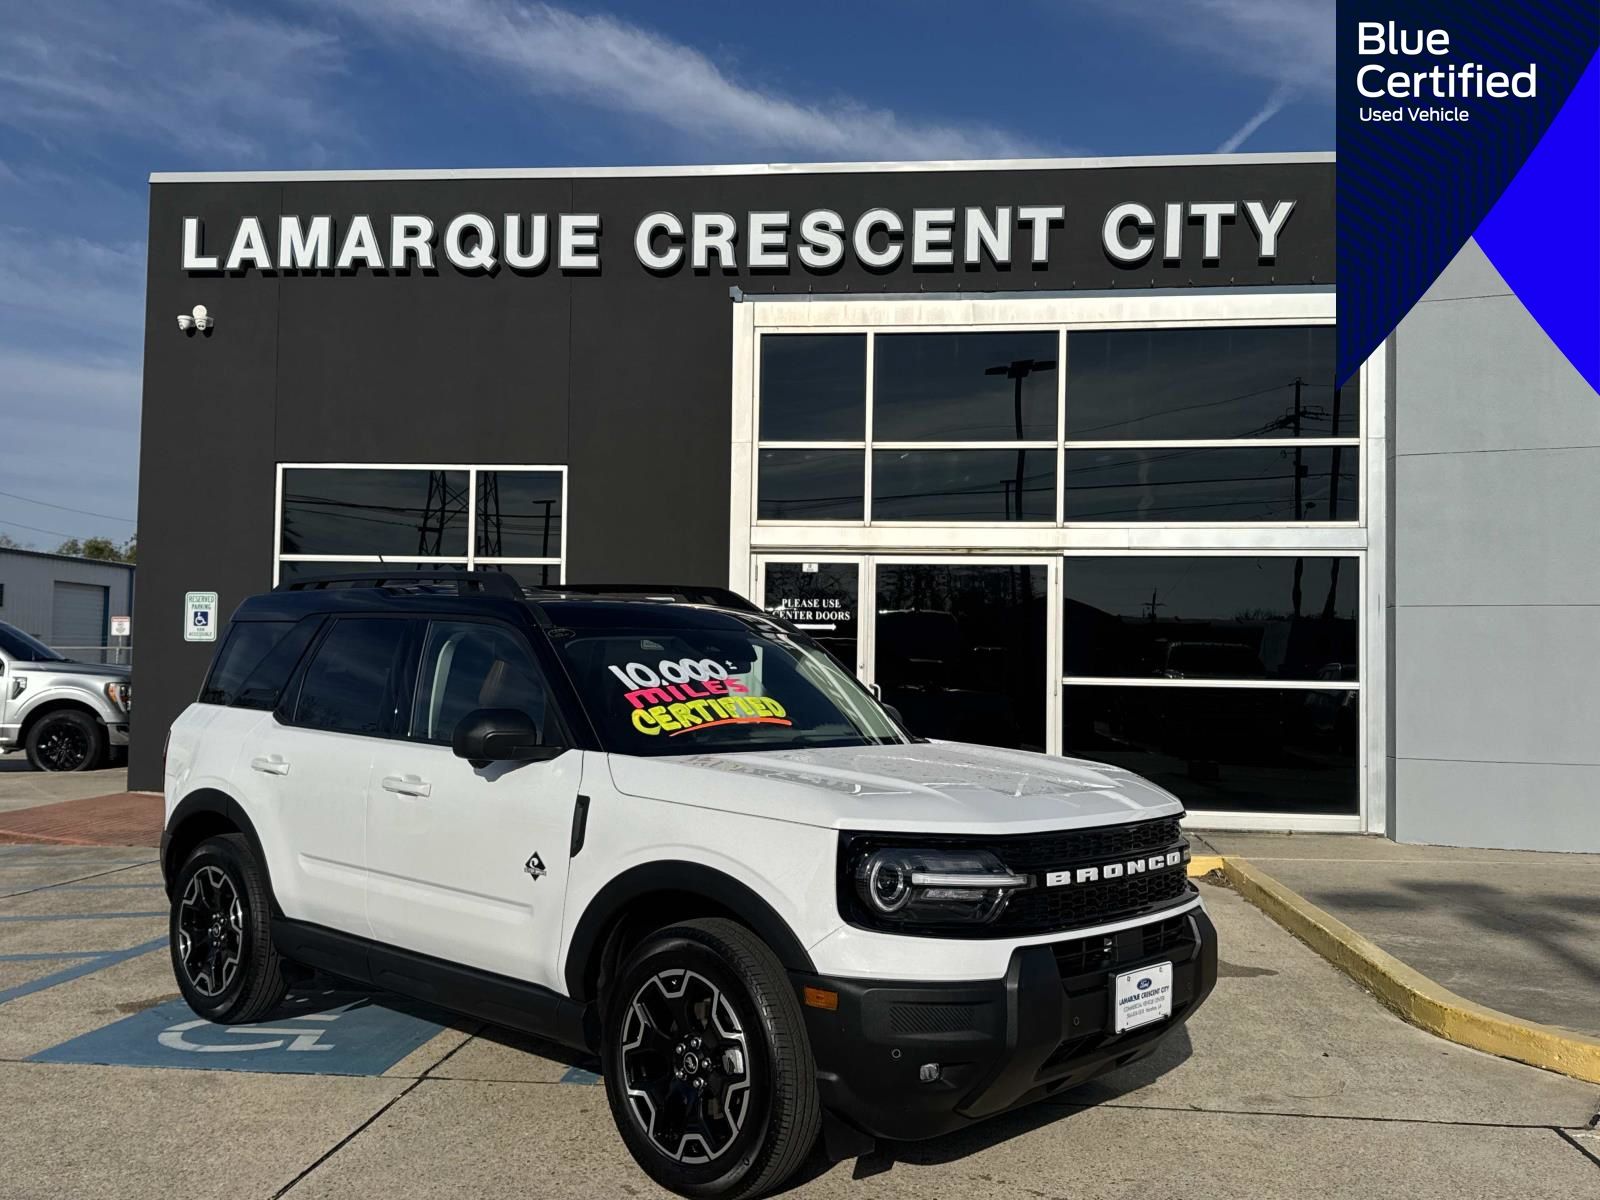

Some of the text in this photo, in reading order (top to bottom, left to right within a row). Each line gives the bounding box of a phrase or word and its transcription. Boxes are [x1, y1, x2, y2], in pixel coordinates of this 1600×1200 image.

[181, 199, 1297, 272] LAMARQUE CRESCENT CITY
[781, 598, 842, 608] PLEASE USE
[815, 610, 851, 621] DOORS
[623, 678, 749, 708] MILES
[631, 696, 787, 735] CERTIFIED
[1046, 851, 1181, 887] BRONCO
